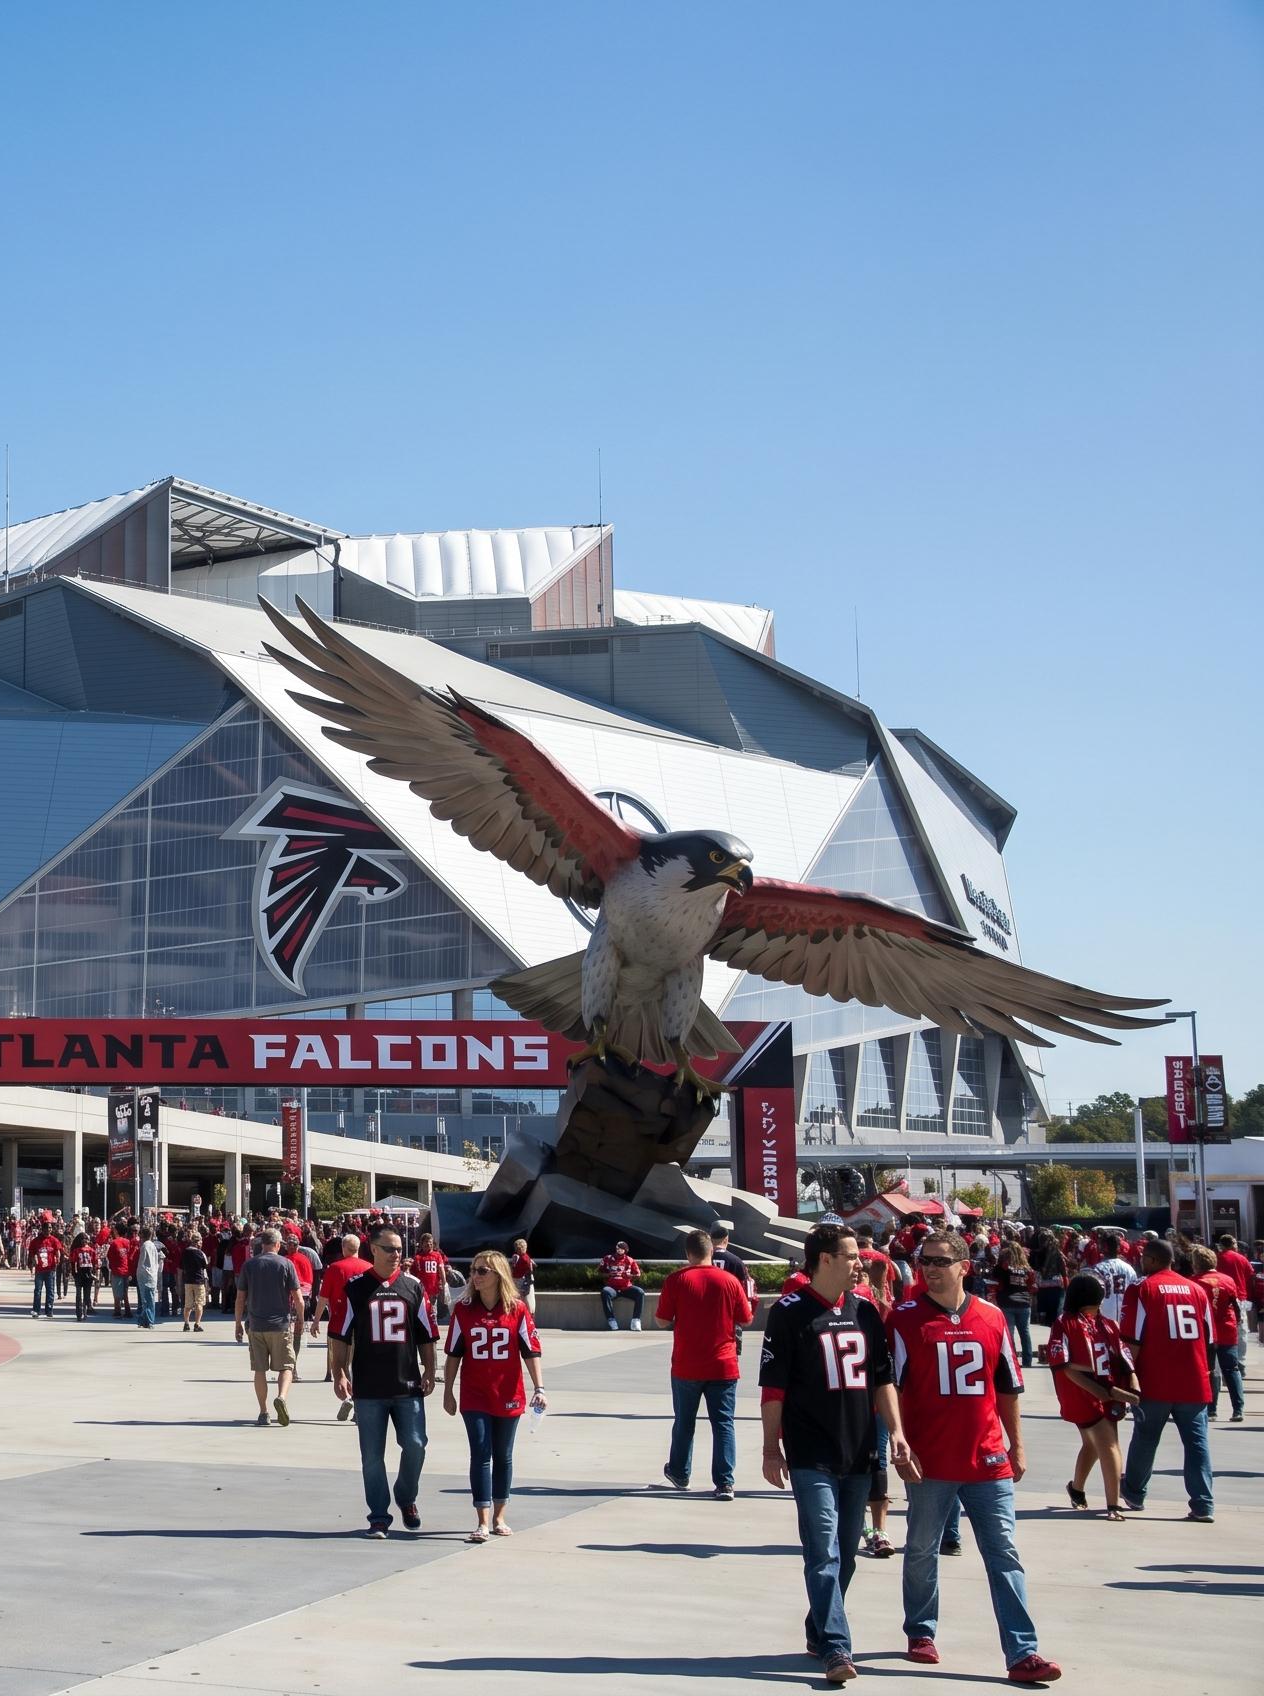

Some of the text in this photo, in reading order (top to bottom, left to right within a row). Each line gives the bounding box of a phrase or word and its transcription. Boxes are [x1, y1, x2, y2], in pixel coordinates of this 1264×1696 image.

[248, 1033, 550, 1070] FALCONS
[369, 1299, 406, 1342] 12
[1166, 1303, 1200, 1340] 16
[470, 1326, 510, 1360] 22
[820, 1331, 867, 1389] 12
[936, 1341, 985, 1395] 12
